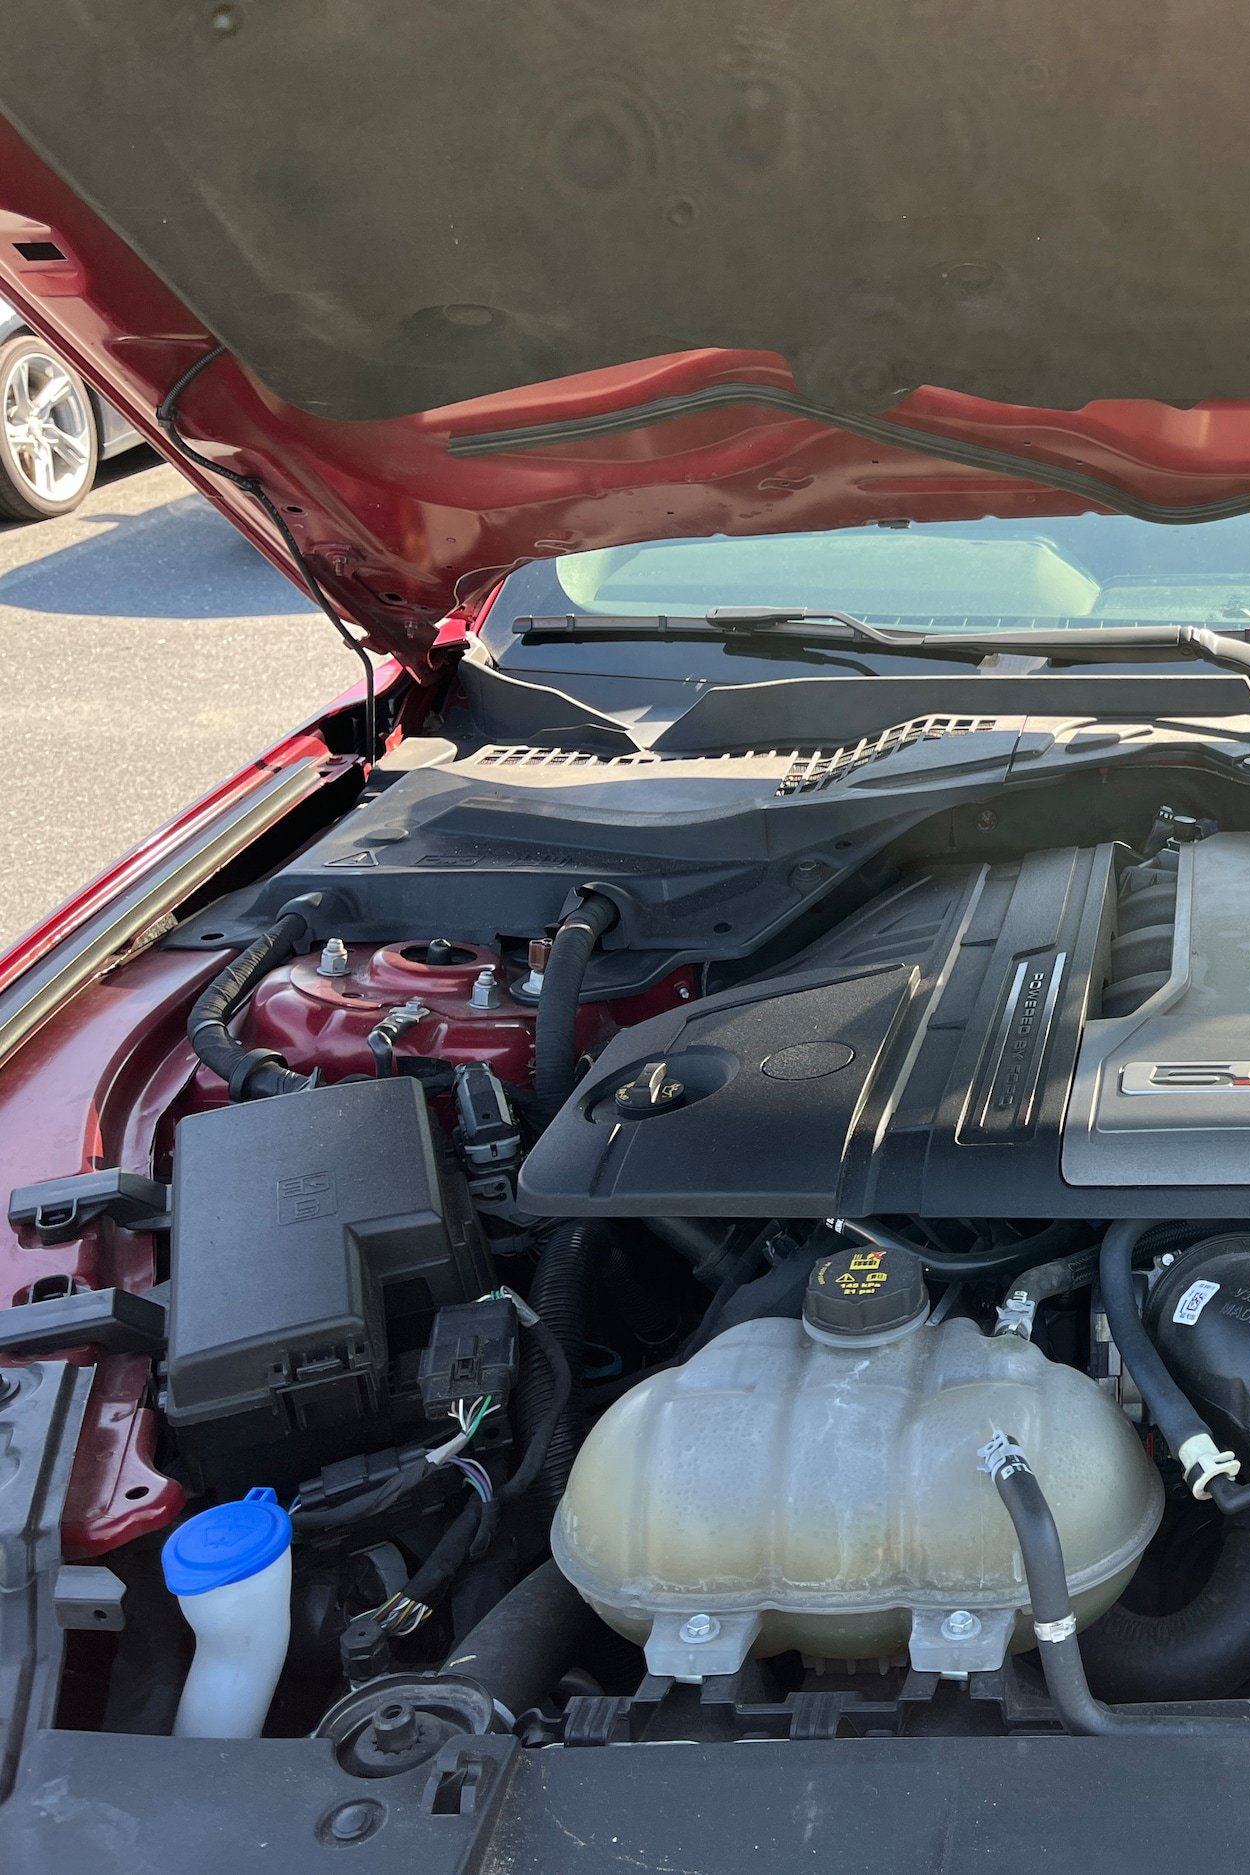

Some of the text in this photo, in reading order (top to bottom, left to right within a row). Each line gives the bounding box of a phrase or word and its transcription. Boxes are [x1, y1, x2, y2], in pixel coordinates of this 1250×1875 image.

[999, 972, 1044, 1105] POWERED BY FORD
